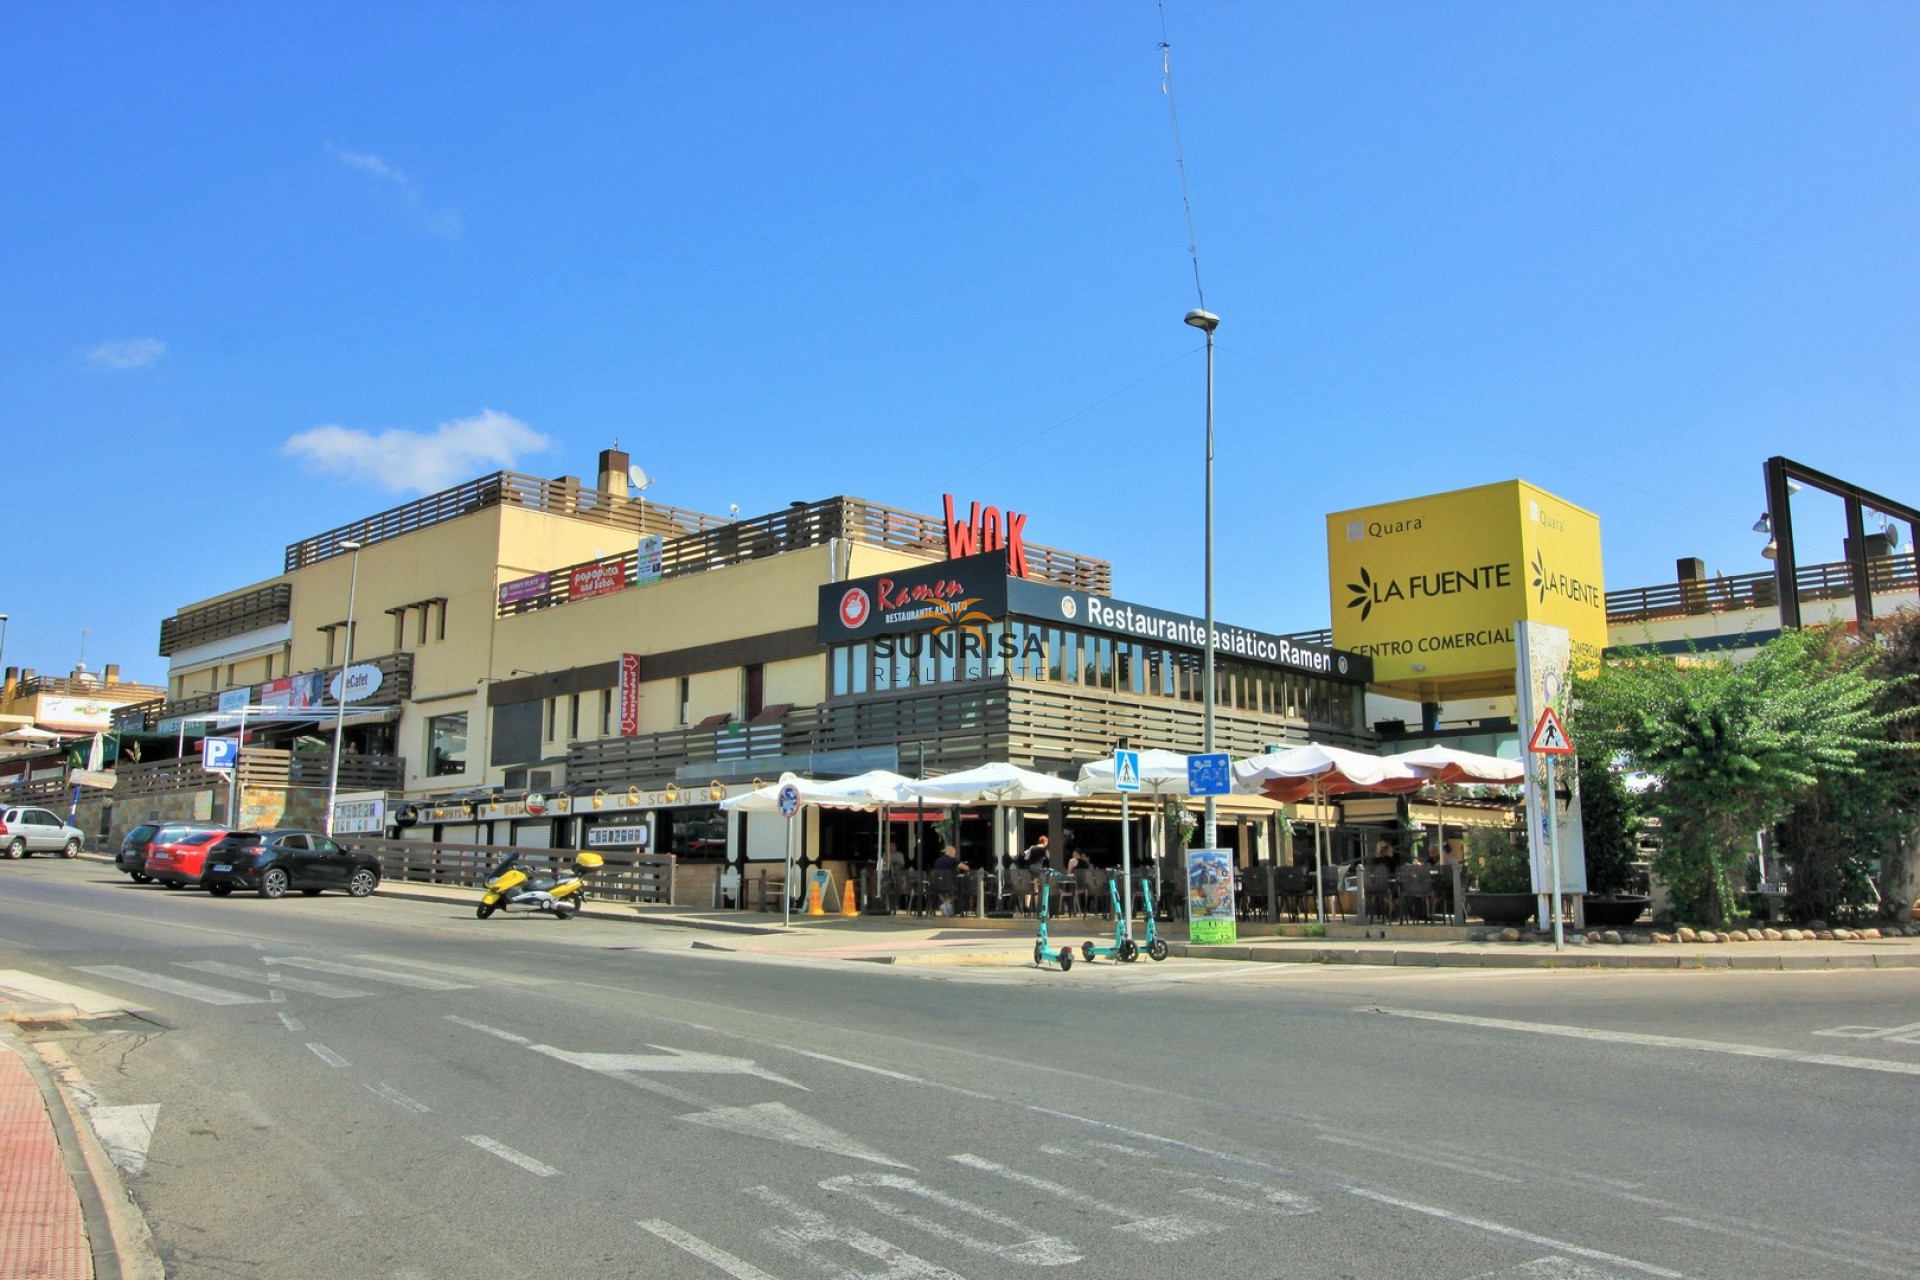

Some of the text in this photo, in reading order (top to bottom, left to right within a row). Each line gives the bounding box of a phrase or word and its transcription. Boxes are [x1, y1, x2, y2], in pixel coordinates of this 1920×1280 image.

[943, 493, 1029, 578] WOK
[1368, 518, 1423, 538] Quara
[1539, 510, 1564, 532] Quara
[877, 578, 965, 612] Ramen
[1373, 563, 1511, 604] LA FUENTE
[1544, 568, 1600, 609] LA FUENTE
[885, 606, 934, 624] RESTAURANTE
[1087, 597, 1332, 671] Restaurante asiático Ramen
[1350, 628, 1515, 657] CENTRO COMERCIAL
[206, 740, 228, 767] P
